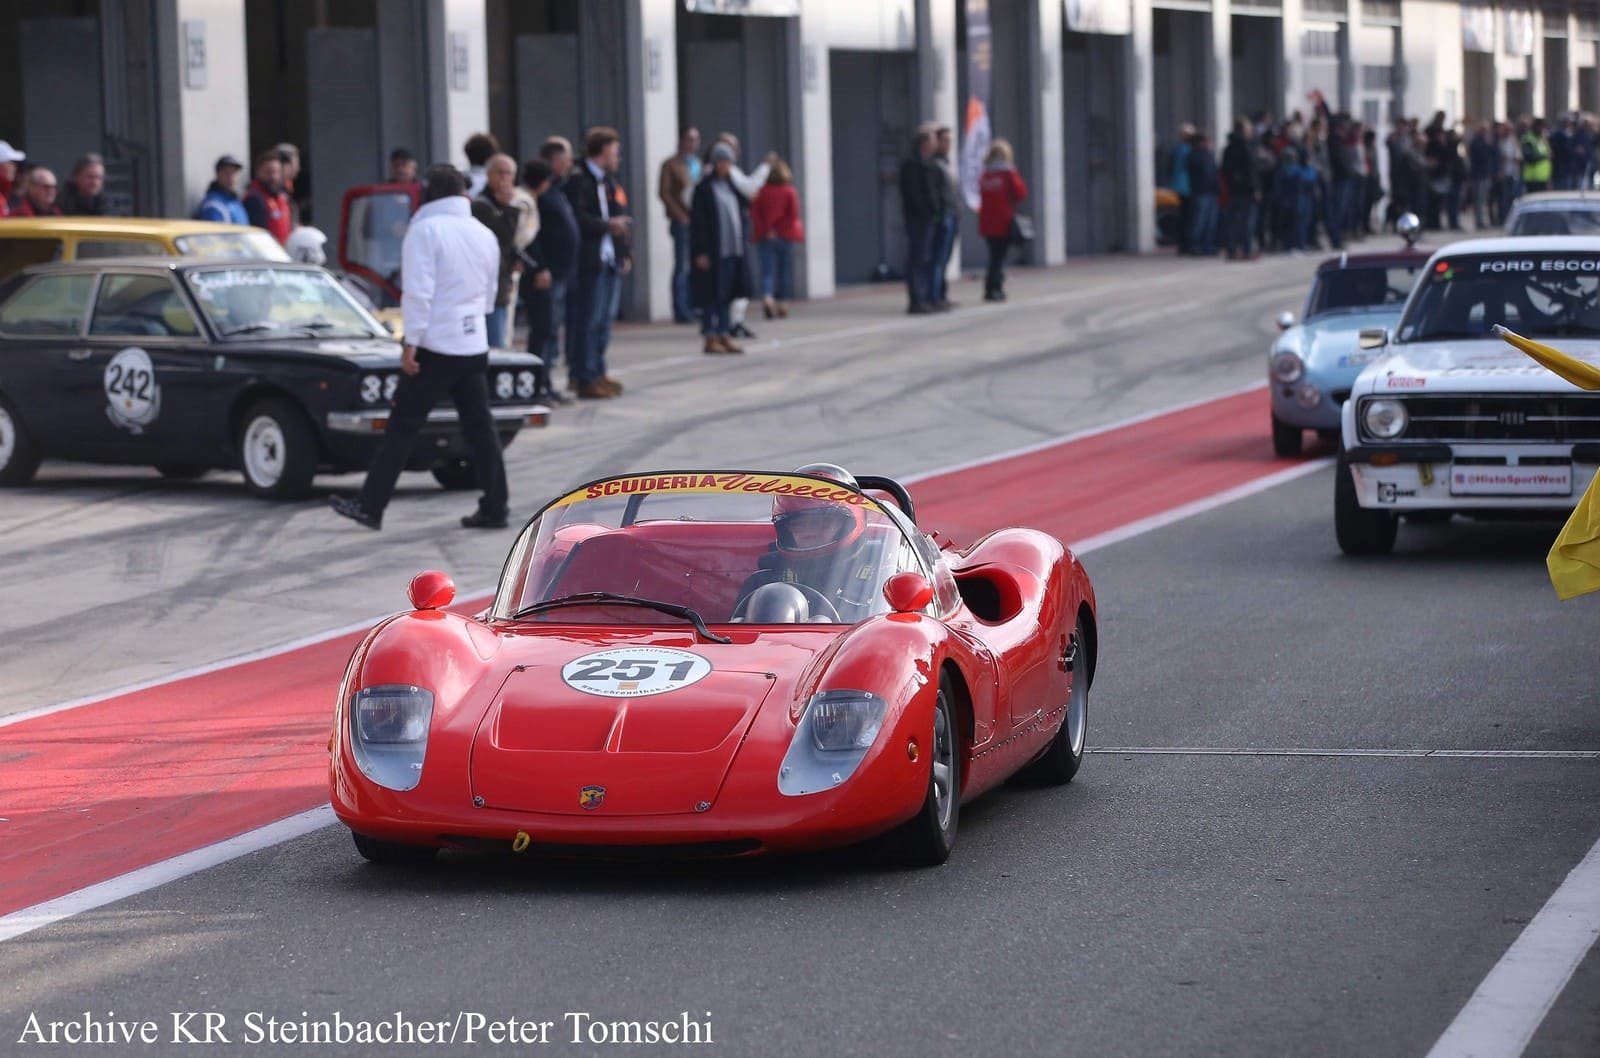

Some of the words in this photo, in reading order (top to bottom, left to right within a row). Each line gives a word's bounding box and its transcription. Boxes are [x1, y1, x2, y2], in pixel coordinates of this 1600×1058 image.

[1480, 260, 1535, 273] FORD
[1540, 260, 1600, 271] ESCO
[109, 363, 150, 401] 242
[586, 474, 717, 499] SCUDERIA
[567, 658, 695, 681] 251
